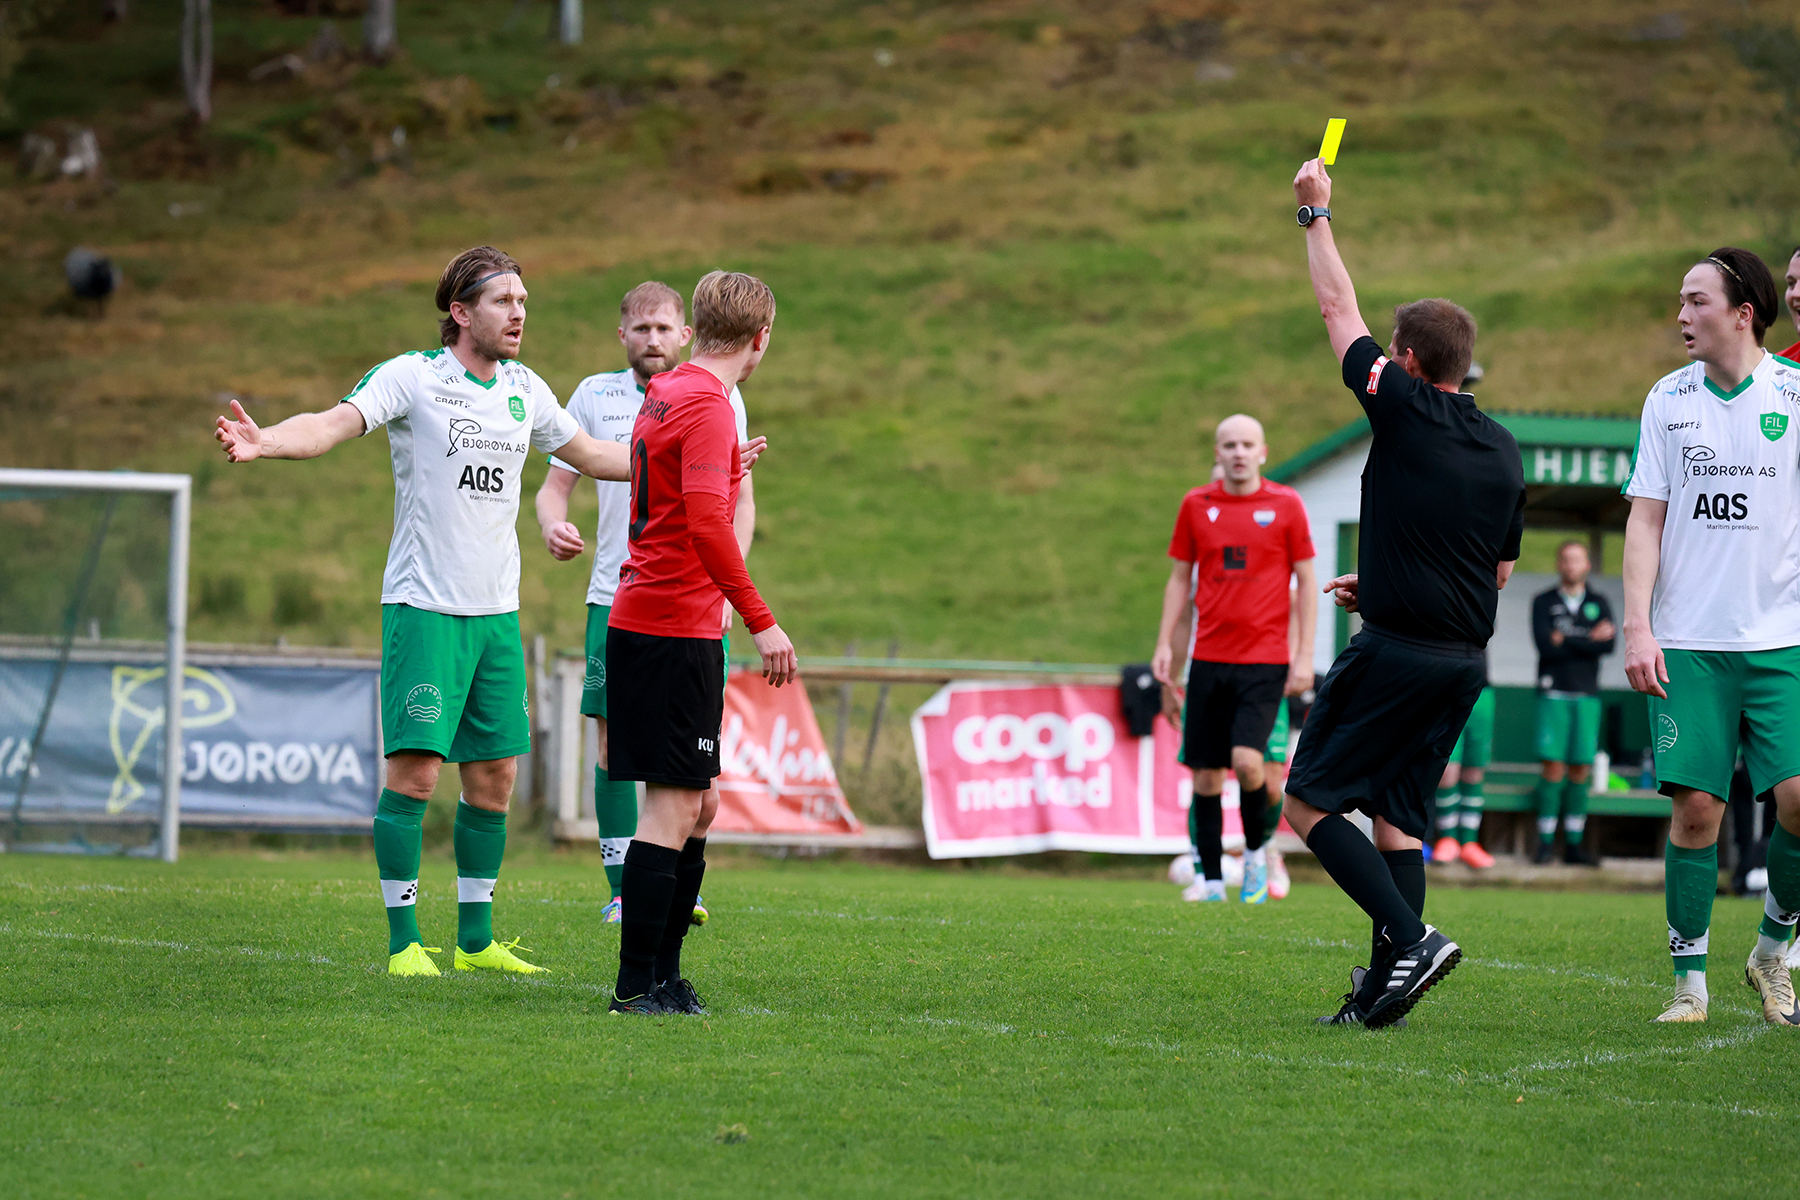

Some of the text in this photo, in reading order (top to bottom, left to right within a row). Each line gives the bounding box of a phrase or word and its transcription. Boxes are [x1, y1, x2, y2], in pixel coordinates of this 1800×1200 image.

[606, 389, 627, 398] NTE
[1679, 384, 1698, 396] NTE
[435, 396, 464, 407] CRAFT
[602, 414, 630, 422] CRAFT
[1765, 416, 1783, 428] FIL
[1667, 421, 1695, 431] CRAFT
[462, 438, 526, 454] BJØRØYA AS
[1693, 465, 1776, 477] BJØRØYA AS
[457, 465, 504, 494] AQS
[1692, 493, 1748, 521] AQS
[1731, 524, 1760, 532] presisjon
[953, 712, 1115, 772] coop
[957, 762, 1112, 812] marked
